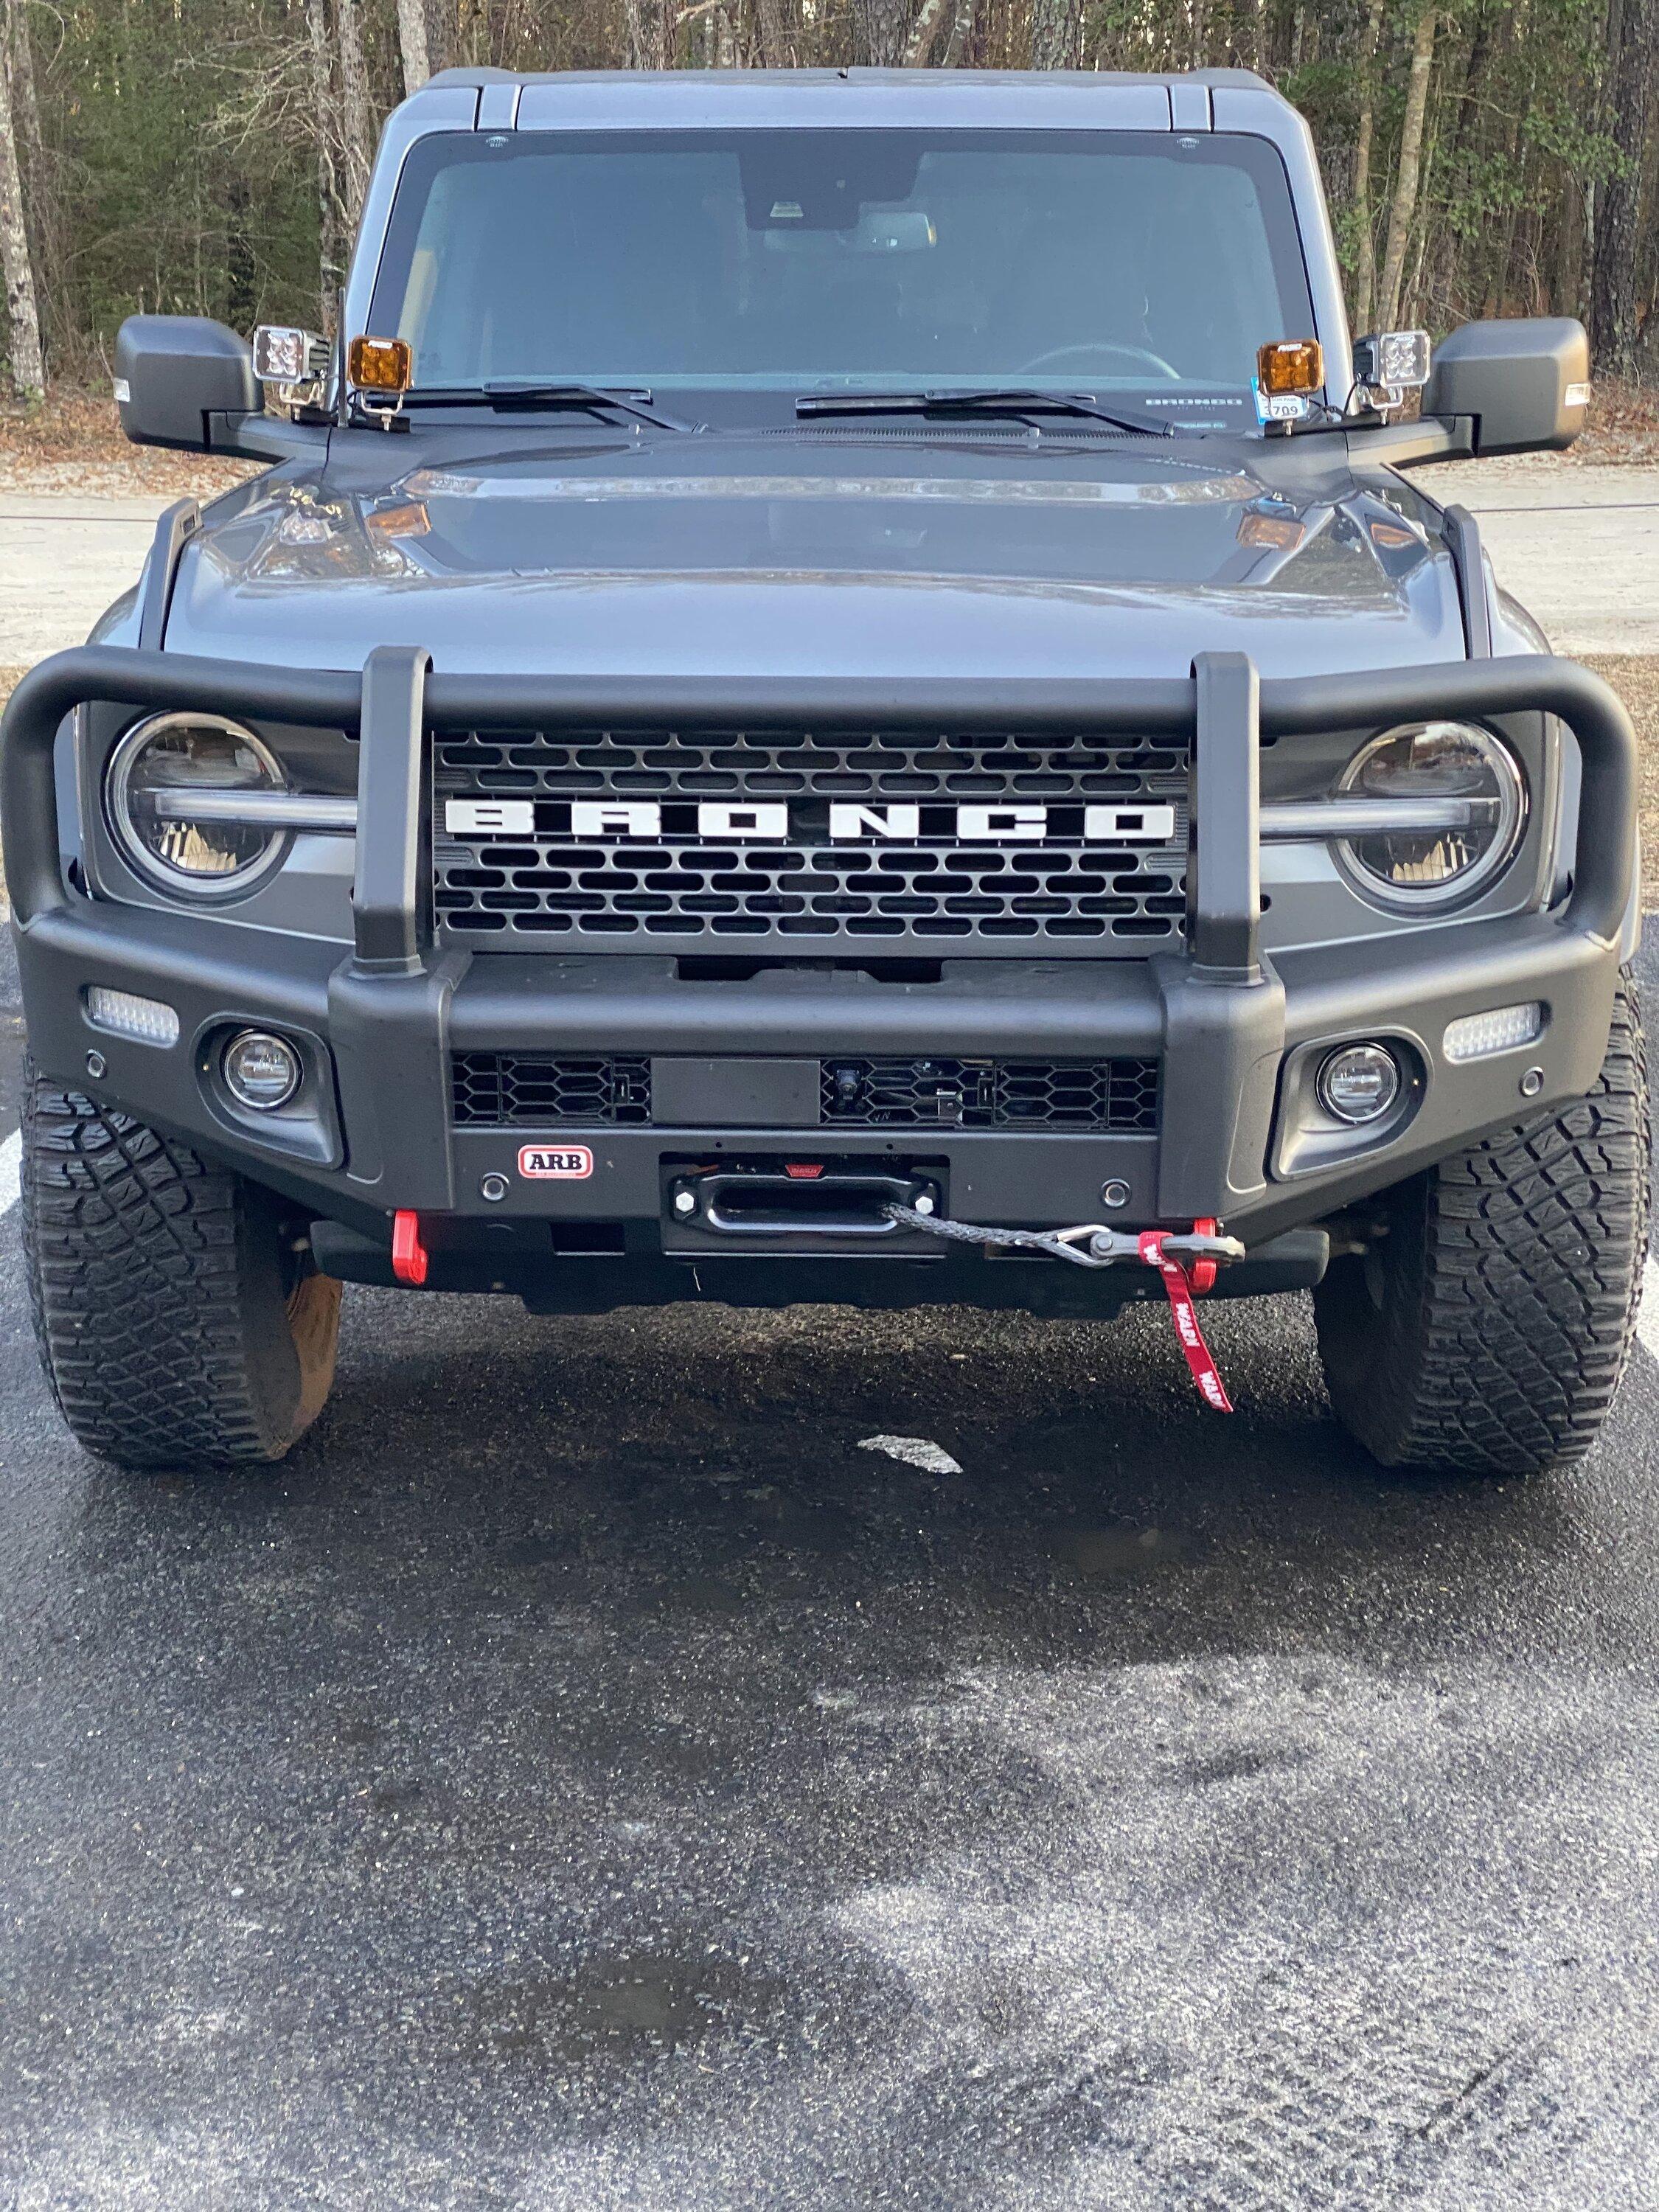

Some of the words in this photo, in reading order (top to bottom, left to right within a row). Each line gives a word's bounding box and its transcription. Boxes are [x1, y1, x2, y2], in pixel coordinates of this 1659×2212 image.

[1264, 406, 1298, 416] 3709
[445, 801, 1178, 839] BRONCO
[529, 1153, 582, 1170] ARB
[1175, 1302, 1201, 1347] WARN
